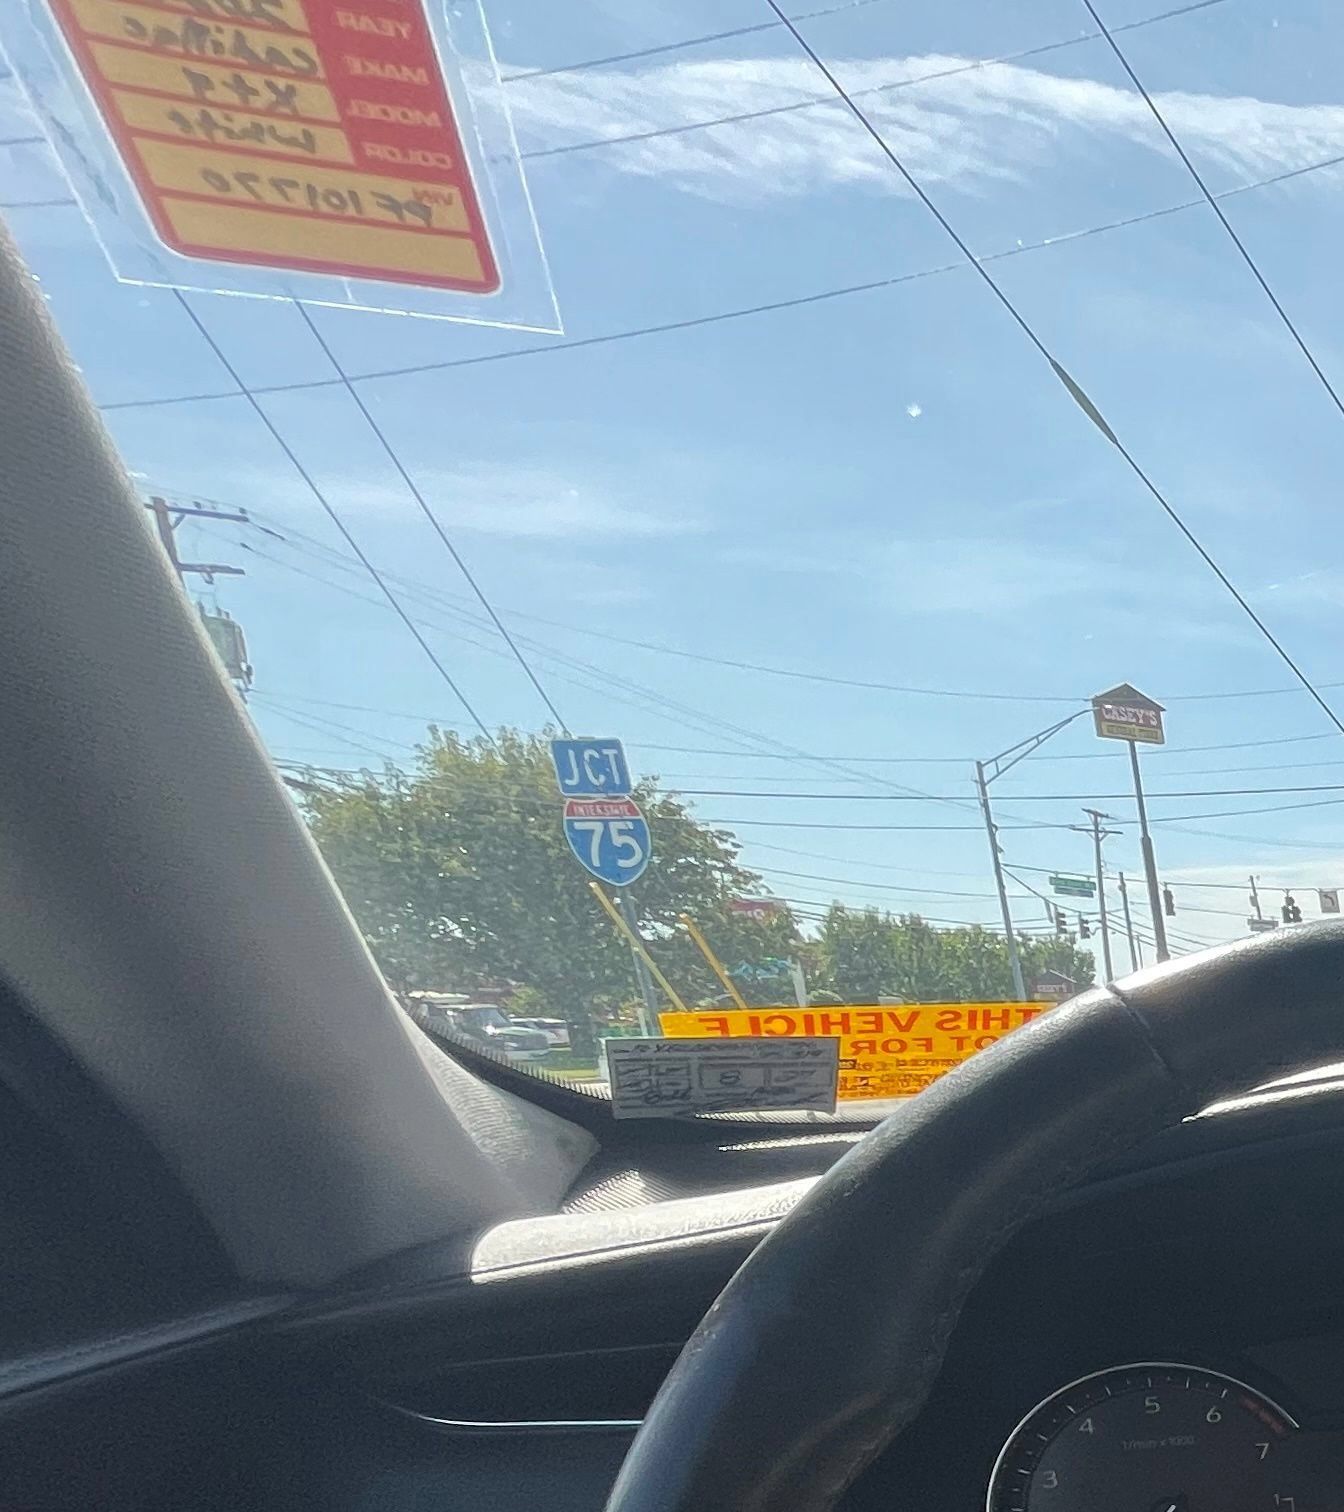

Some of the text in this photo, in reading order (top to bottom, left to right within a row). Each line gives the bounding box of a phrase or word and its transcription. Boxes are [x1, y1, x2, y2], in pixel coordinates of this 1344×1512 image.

[565, 749, 622, 786] JCT
[573, 803, 631, 817] INTERSTATE
[573, 821, 643, 869] 75
[1144, 1396, 1161, 1415] 5
[1206, 1405, 1223, 1424] 6
[1078, 1418, 1095, 1435] 4
[1255, 1442, 1270, 1460] 7
[1042, 1471, 1058, 1488] 3
